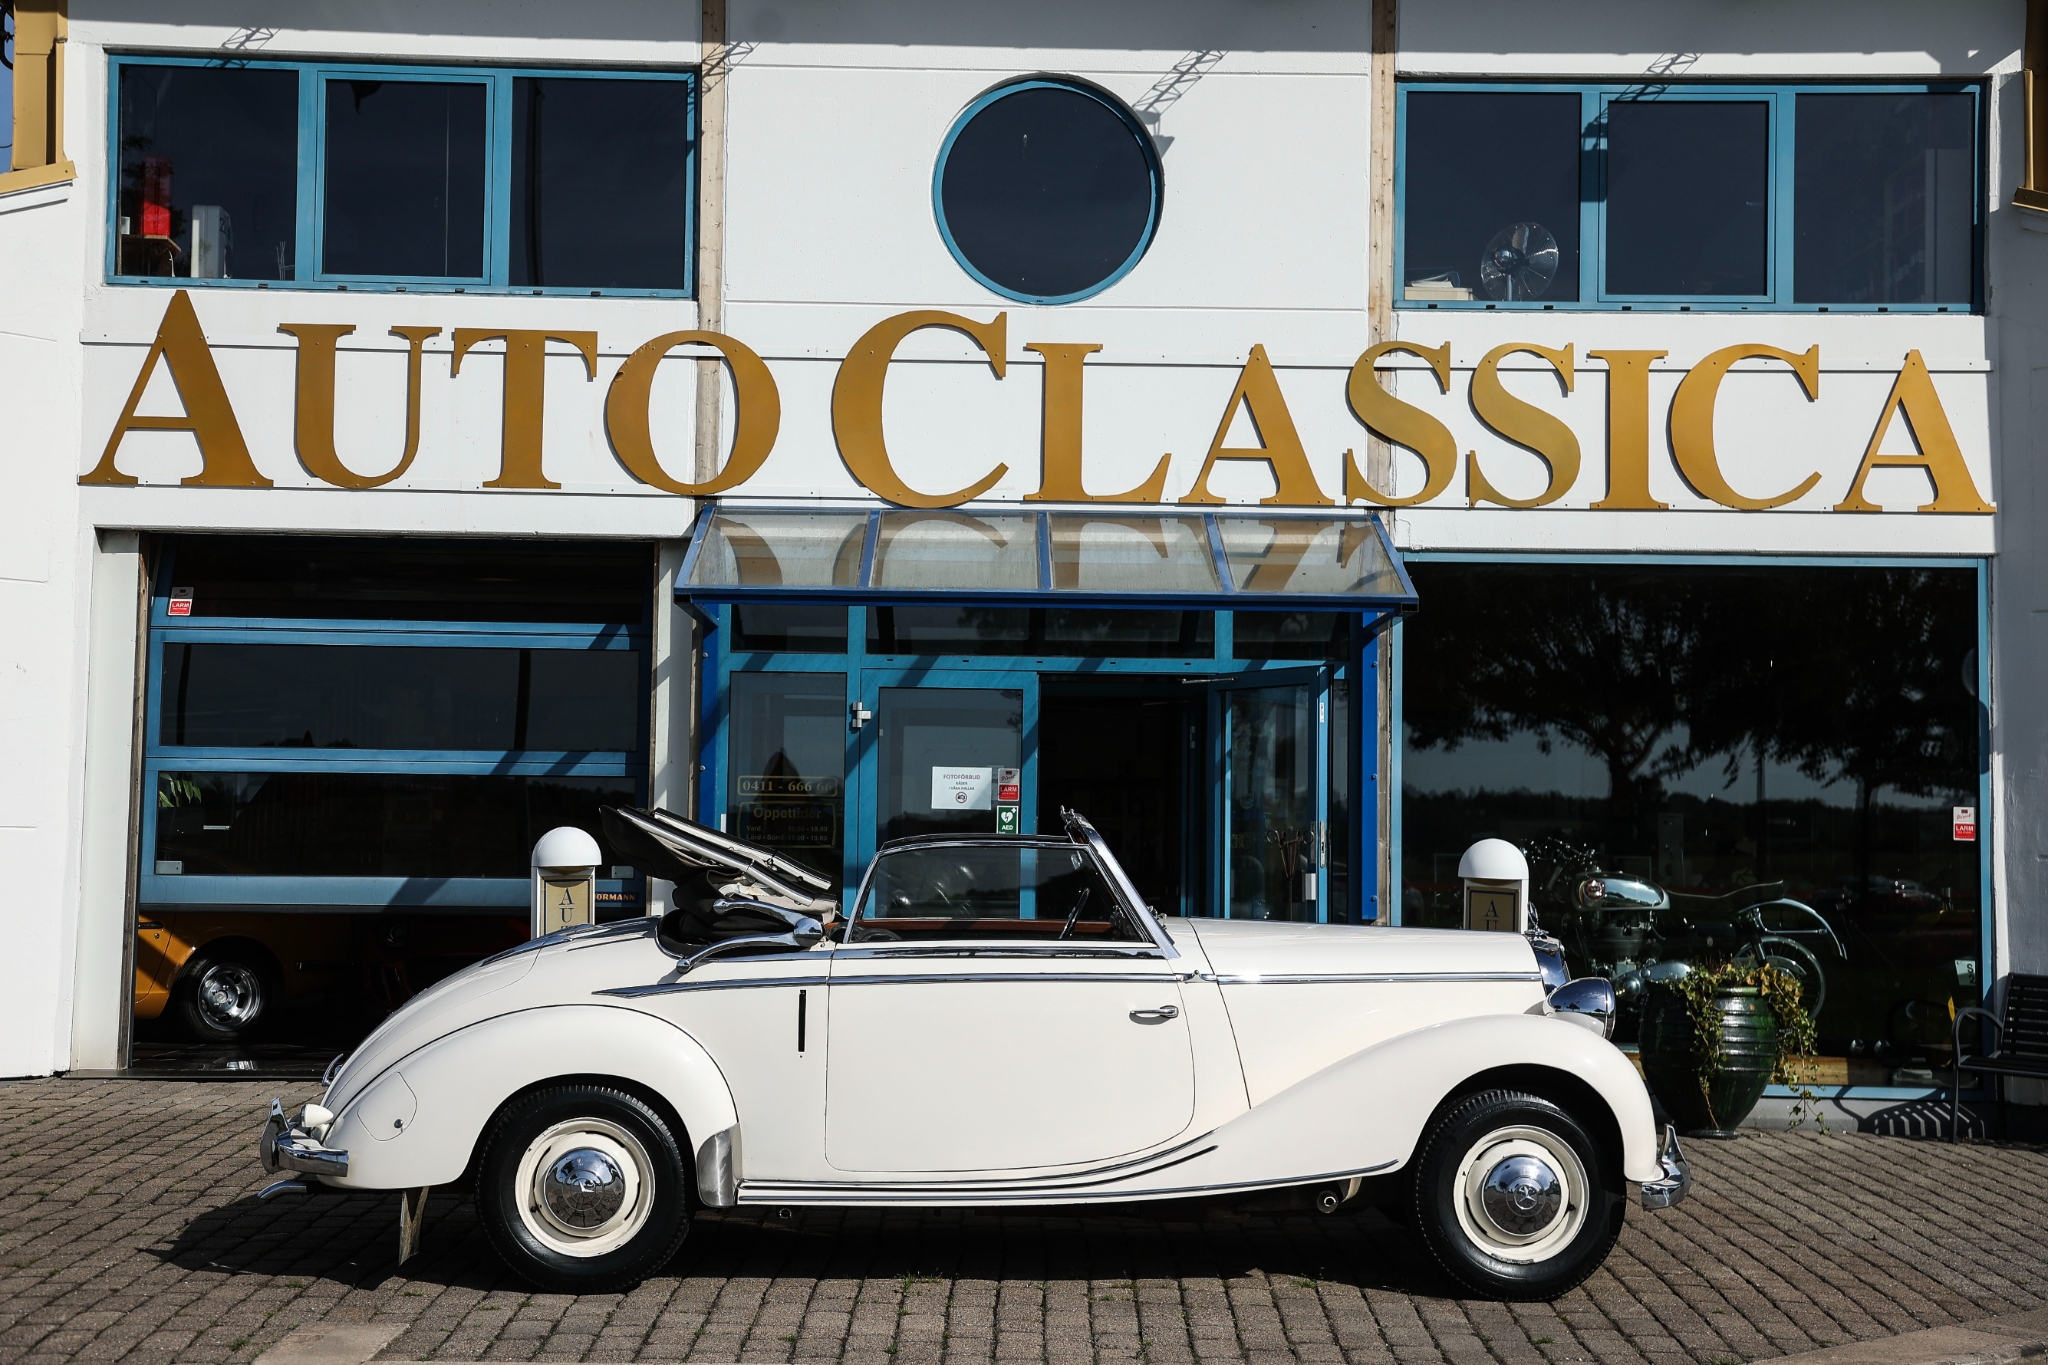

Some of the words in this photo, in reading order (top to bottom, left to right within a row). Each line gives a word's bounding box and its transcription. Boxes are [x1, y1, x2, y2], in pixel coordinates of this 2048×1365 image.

[79, 289, 781, 496] AUTO
[831, 310, 1998, 514] CLASSICA
[742, 780, 774, 791] 0411
[787, 781, 812, 792] 666
[816, 781, 833, 792] 66
[753, 804, 822, 821] Öppettider
[595, 892, 636, 901] ÖRMANN
[558, 887, 575, 930] AU
[1966, 963, 1974, 974] S
